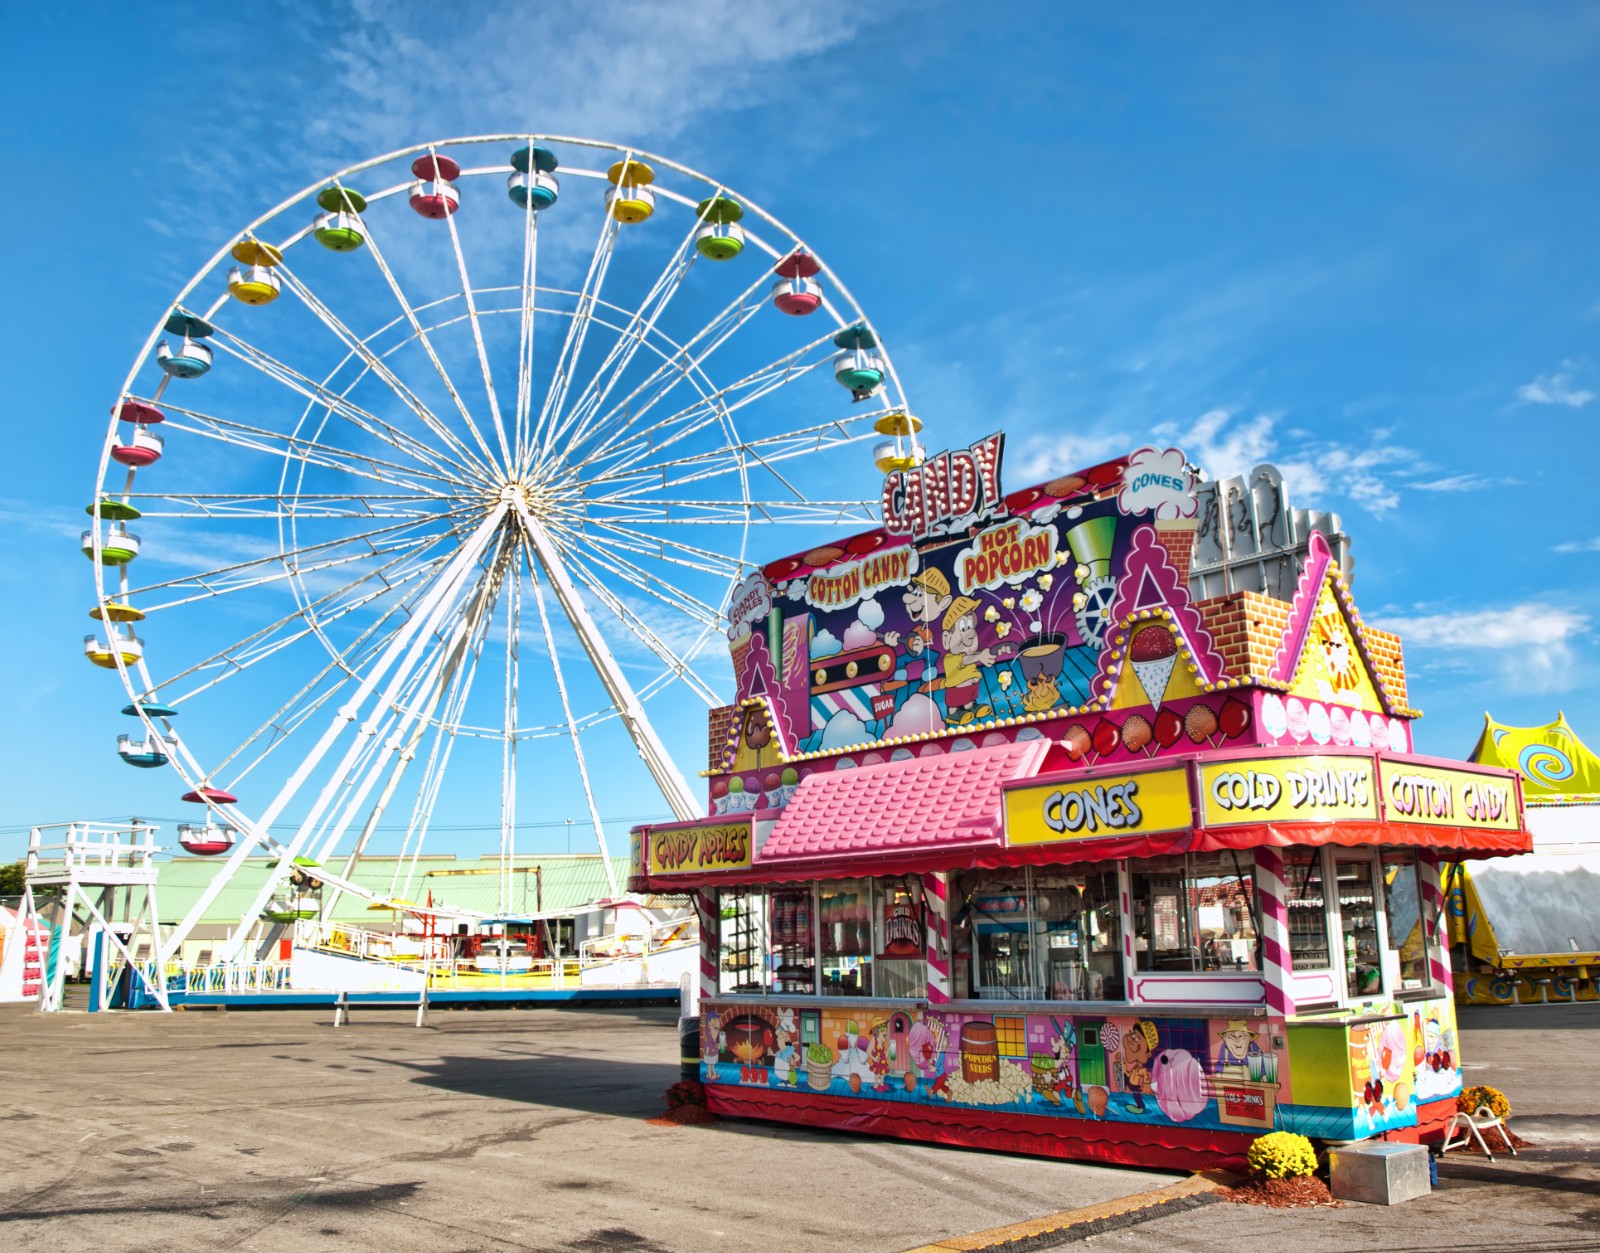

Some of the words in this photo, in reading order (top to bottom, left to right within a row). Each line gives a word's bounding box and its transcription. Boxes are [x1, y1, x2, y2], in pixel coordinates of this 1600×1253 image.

[881, 430, 1004, 541] CANDY
[1132, 473, 1183, 493] CONES
[981, 522, 1020, 552] HOT
[809, 569, 860, 602] COTTON
[863, 550, 911, 589] CANDY
[964, 532, 1050, 592] POPCORN
[733, 587, 759, 618] CANDY
[734, 596, 763, 628] APPLES
[874, 698, 894, 713] SUGAR
[1211, 770, 1281, 811] COLD
[1286, 768, 1368, 807] DRINKS
[1391, 772, 1454, 818] COTTON
[1463, 782, 1509, 822] CANDY
[1043, 781, 1142, 833] CONES
[655, 831, 697, 869] CANDY
[698, 827, 748, 867] APPLES
[893, 906, 910, 917] COLD
[885, 918, 920, 946] DRINKS
[964, 1052, 997, 1064] POPCORN
[970, 1063, 992, 1074] SEEDS
[1226, 1093, 1241, 1103] COLD
[1243, 1094, 1264, 1106] DRINKS
